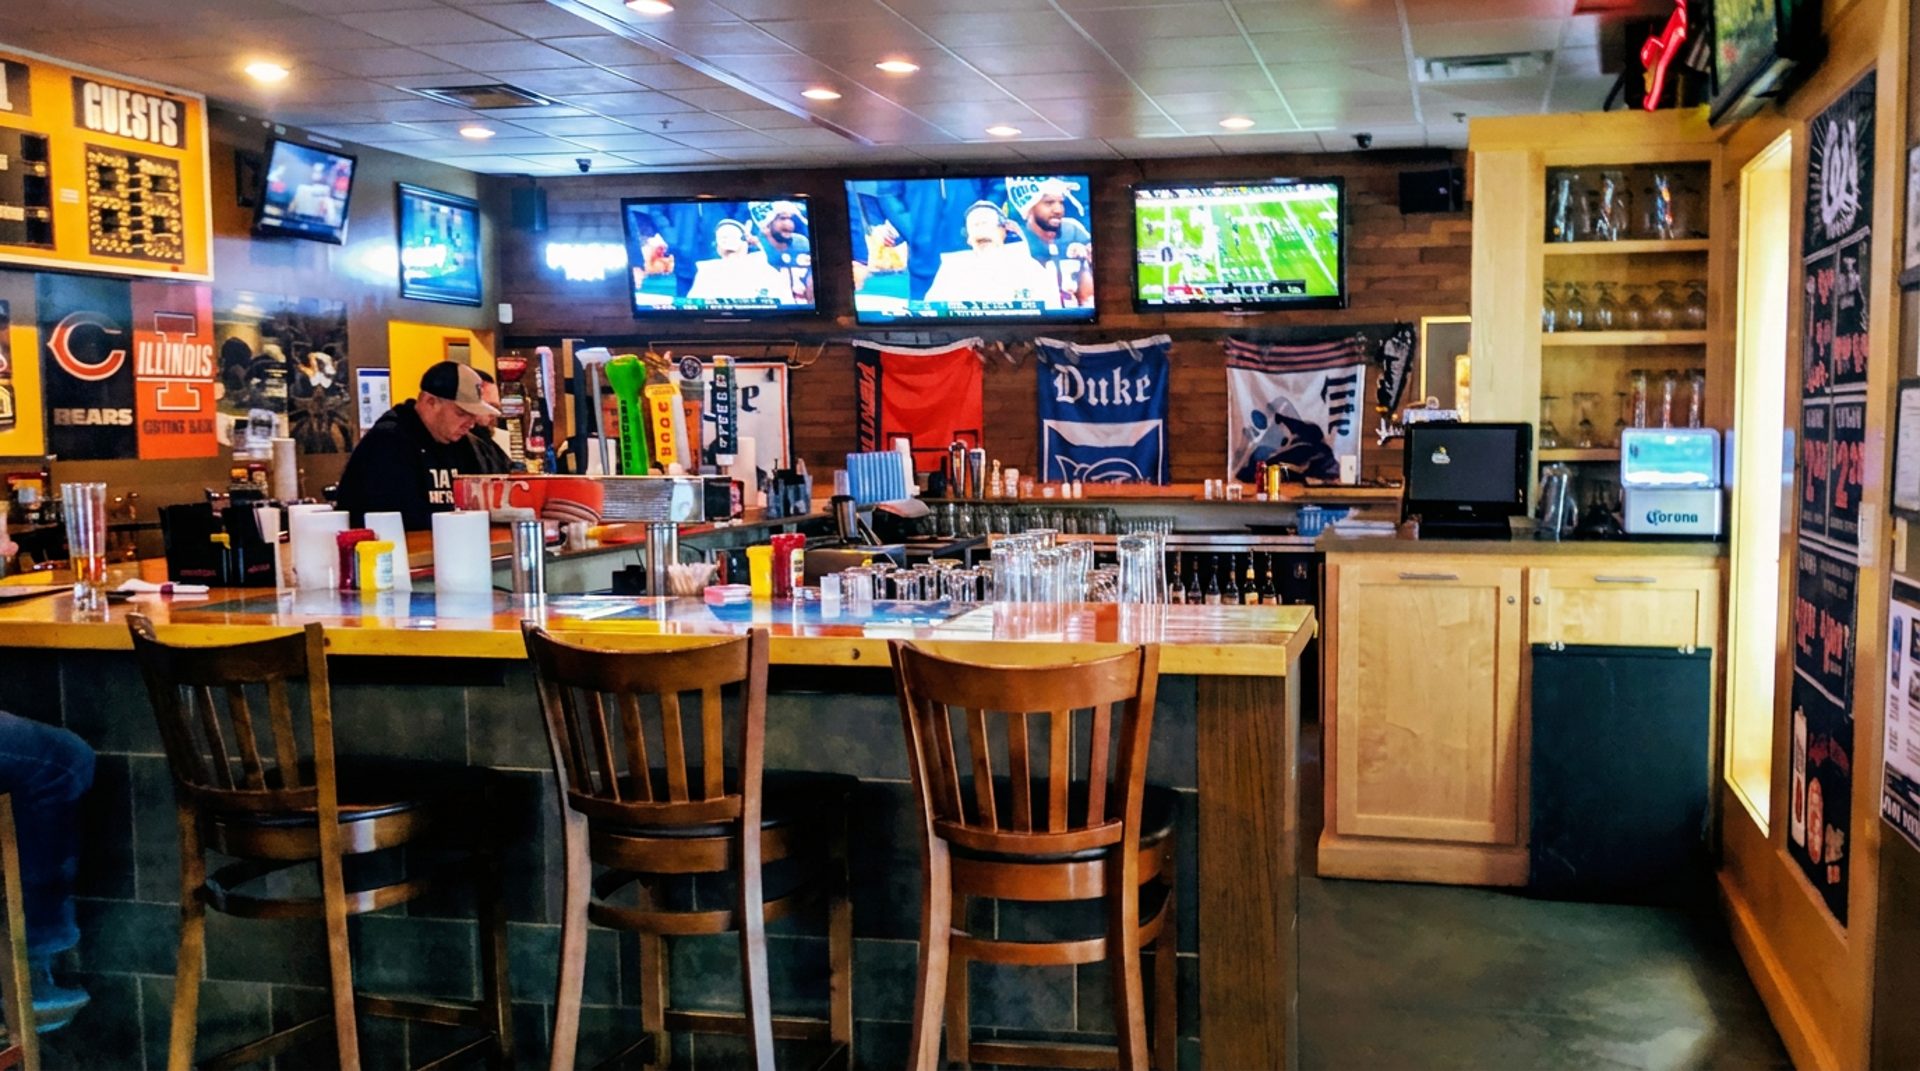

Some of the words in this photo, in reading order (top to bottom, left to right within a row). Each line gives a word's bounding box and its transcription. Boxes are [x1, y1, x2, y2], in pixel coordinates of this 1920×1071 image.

[83, 82, 178, 146] GUESTS
[137, 341, 213, 377] ILLINOIS
[1053, 363, 1152, 406] Duke
[53, 408, 133, 426] BEARS
[1646, 509, 1698, 526] Corona
